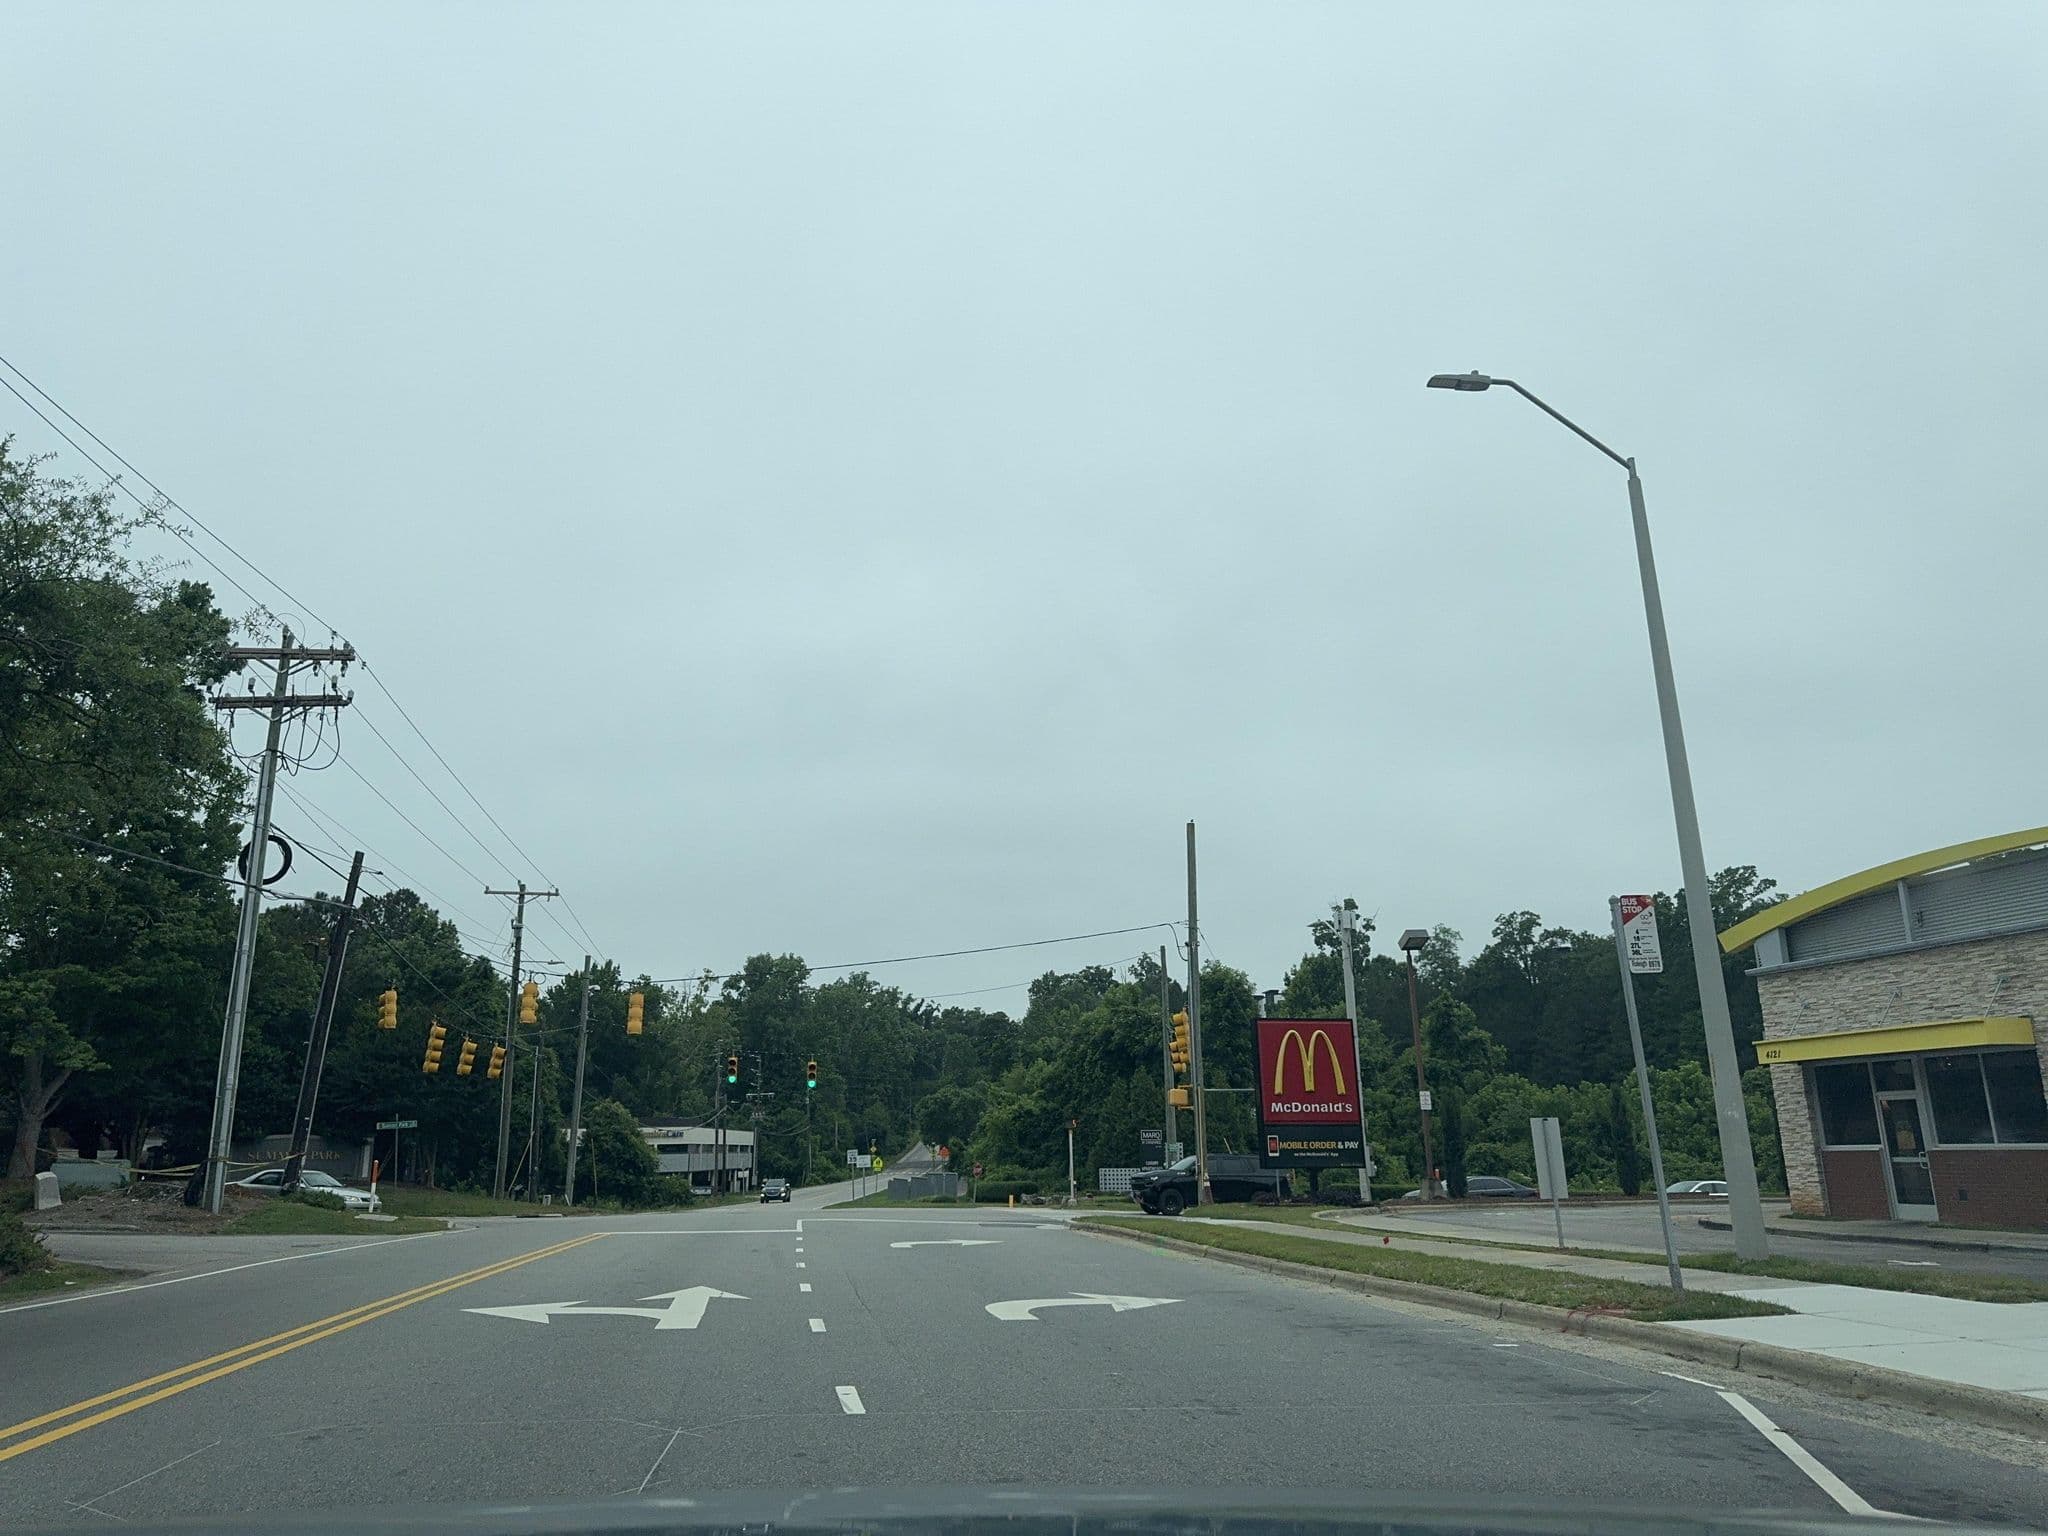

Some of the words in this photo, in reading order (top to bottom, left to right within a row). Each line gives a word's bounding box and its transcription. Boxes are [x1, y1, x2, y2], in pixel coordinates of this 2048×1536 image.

[1623, 906, 1642, 914] STOP
[1271, 1102, 1353, 1113] McDonald's
[1280, 1141, 1308, 1150] MOBILE
[1309, 1141, 1336, 1149] ORDER
